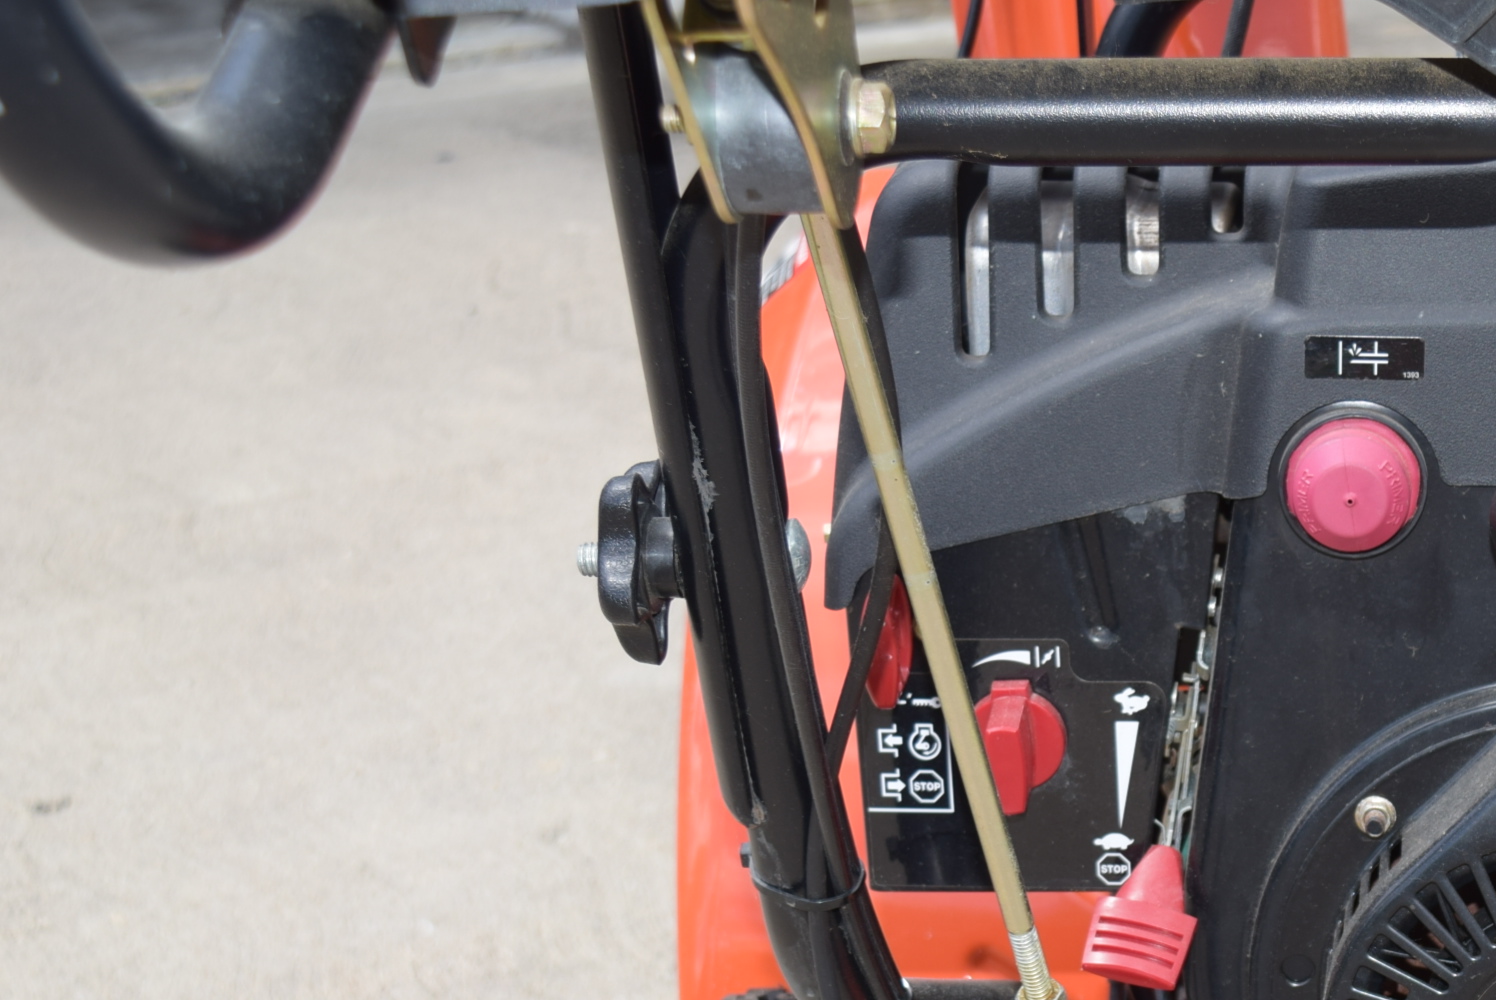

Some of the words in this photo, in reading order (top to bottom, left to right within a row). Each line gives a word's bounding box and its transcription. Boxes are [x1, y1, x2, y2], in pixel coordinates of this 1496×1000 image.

[1378, 460, 1404, 525] PRIMER
[914, 781, 941, 792] STOP
[1101, 864, 1128, 874] STOP
